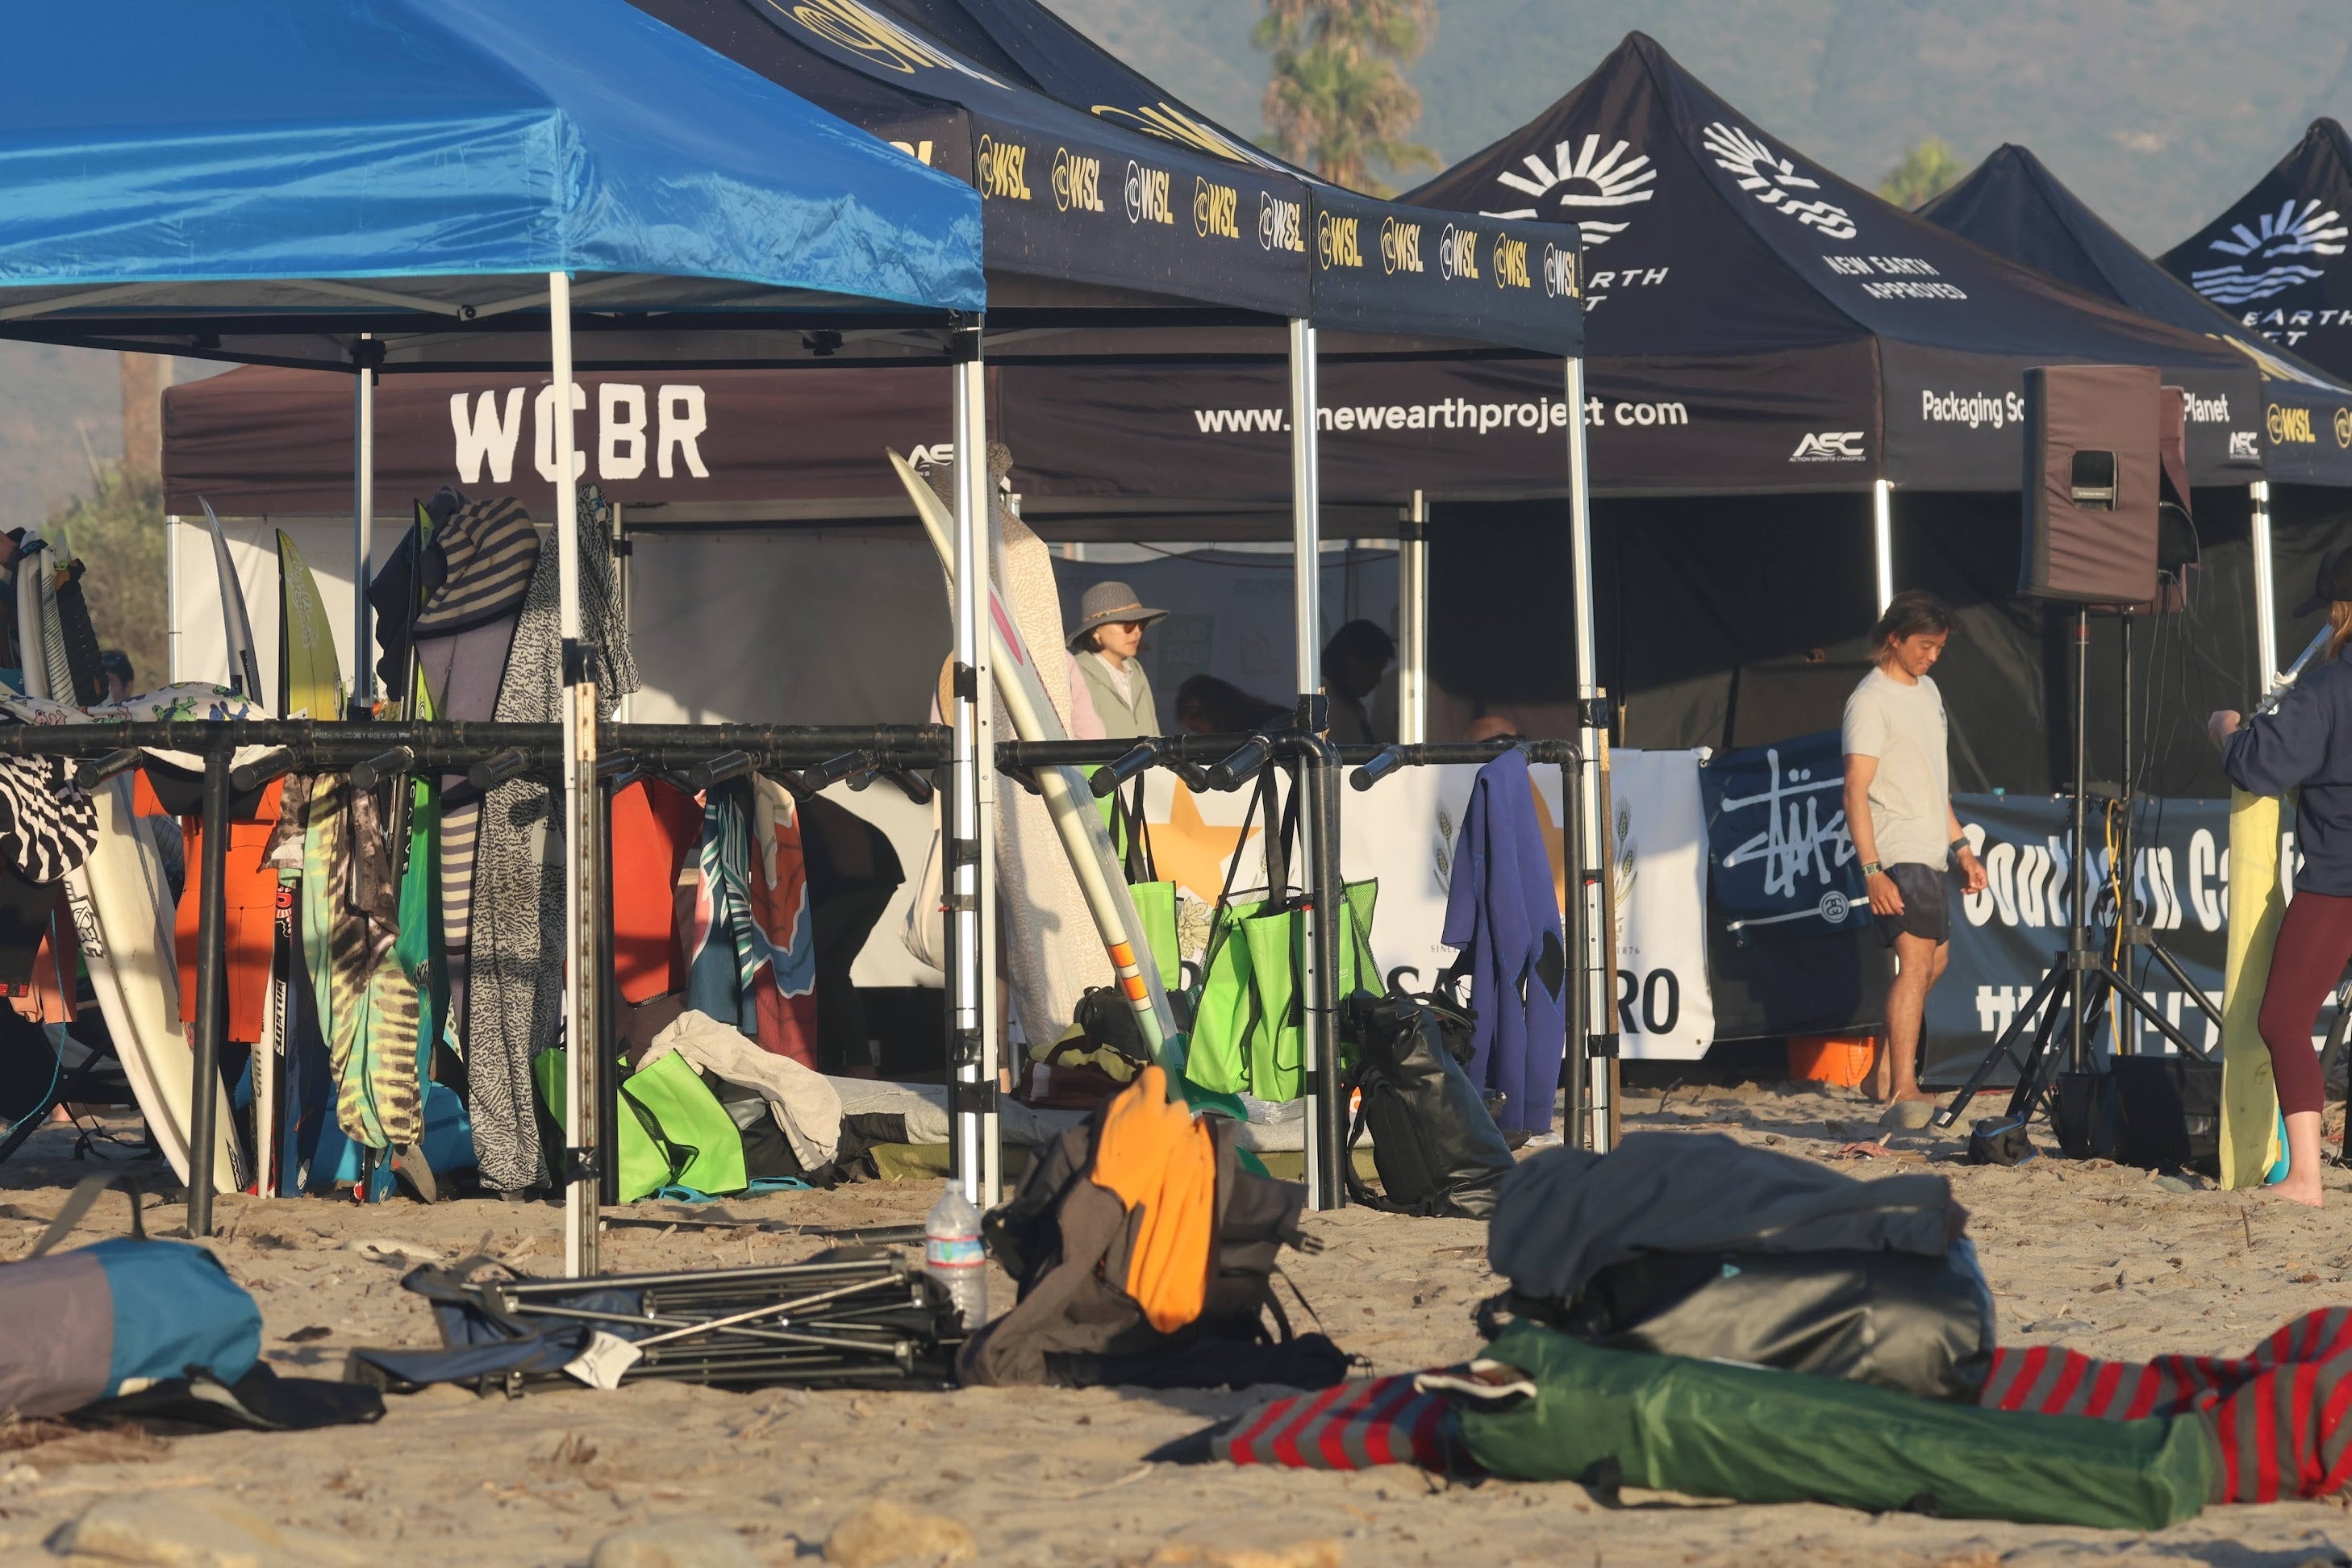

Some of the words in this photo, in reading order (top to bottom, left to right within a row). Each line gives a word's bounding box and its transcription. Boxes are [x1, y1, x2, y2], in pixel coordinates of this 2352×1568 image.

[993, 143, 1031, 200] WSL
[1070, 155, 1104, 212] WSL
[1141, 168, 1174, 224] WSL
[1209, 183, 1239, 239] WSL
[1273, 199, 1305, 252] WSL
[1332, 217, 1363, 267] WSL
[1395, 223, 1424, 273] WSL
[1453, 230, 1479, 279] WSL
[1506, 240, 1531, 288] WSL
[1823, 256, 1875, 275] NEW
[1869, 256, 1940, 276] EARTH
[1555, 249, 1579, 298] WSL
[1588, 267, 1669, 289] RTH
[1862, 282, 1968, 300] APPROVED
[1922, 390, 2004, 429] Packaging
[2183, 392, 2230, 423] Planet
[2282, 408, 2316, 443] WSL
[449, 382, 710, 484] WCBR
